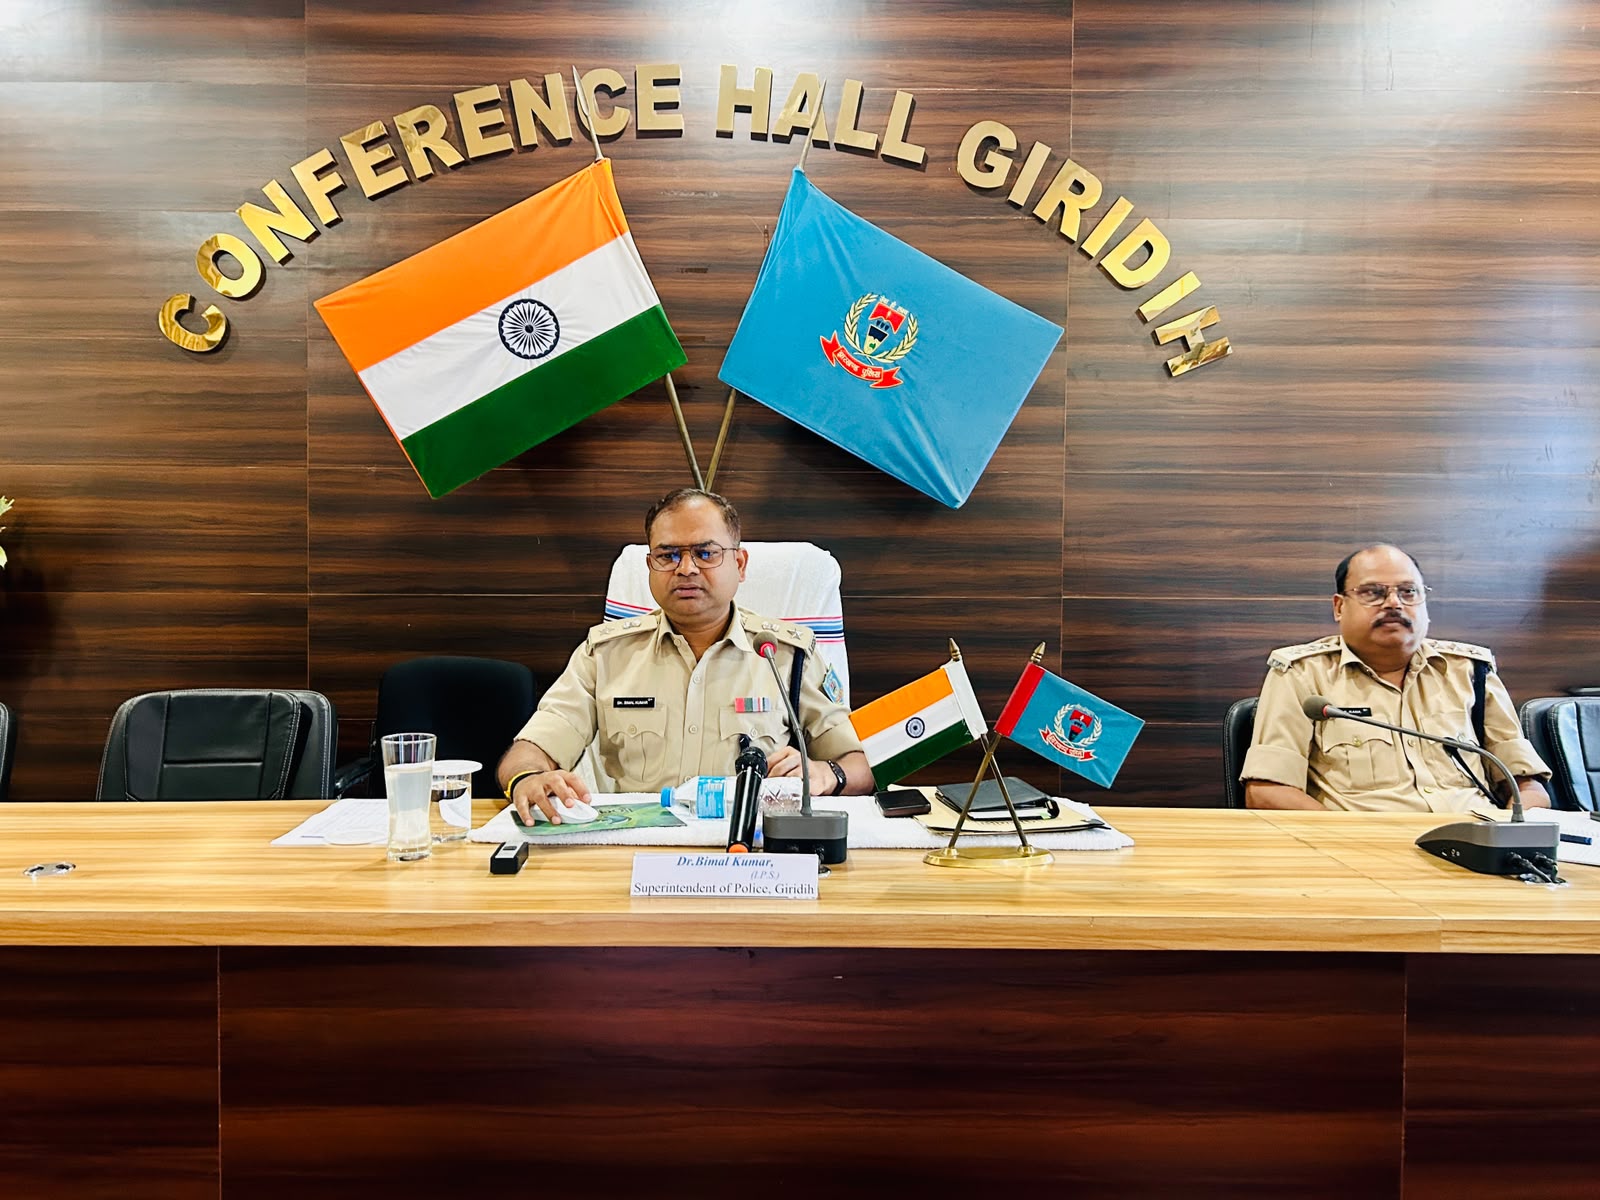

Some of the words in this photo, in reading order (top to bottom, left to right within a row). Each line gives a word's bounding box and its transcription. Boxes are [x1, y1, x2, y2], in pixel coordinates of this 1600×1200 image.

[158, 64, 684, 354] CONFERENCE
[716, 63, 926, 165] HALL
[956, 120, 1234, 378] GIRIDIH
[731, 856, 774, 868] Kumar,
[633, 882, 716, 896] Superintendent
[719, 882, 733, 894] of
[734, 884, 771, 895] Police,
[774, 884, 814, 895] Giridih
